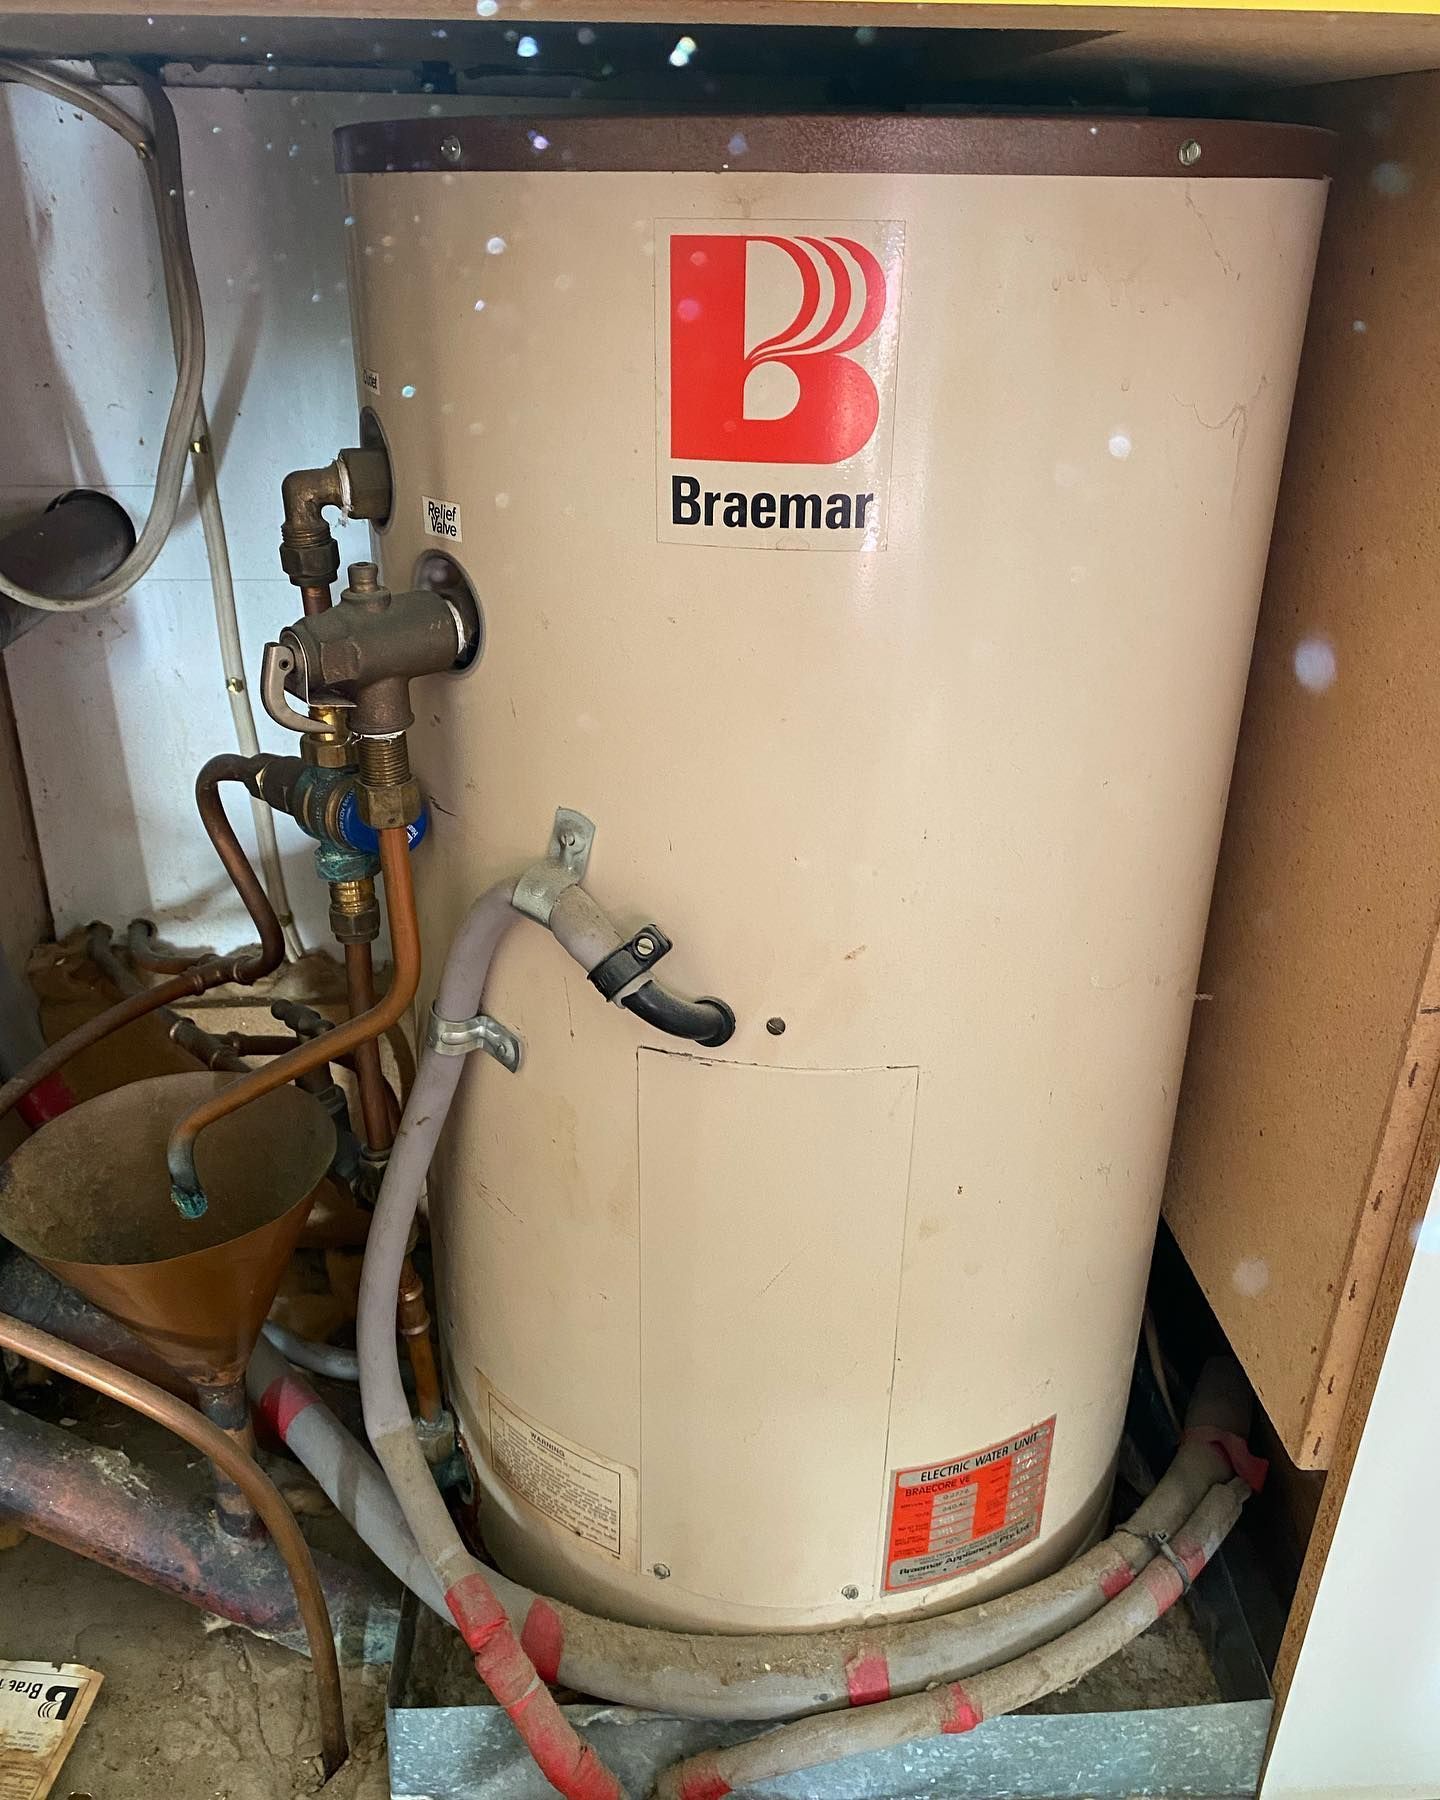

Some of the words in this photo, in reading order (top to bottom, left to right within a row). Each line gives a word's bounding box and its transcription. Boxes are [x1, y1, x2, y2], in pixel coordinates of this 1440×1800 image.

[428, 501, 457, 522] Relief
[672, 474, 874, 529] Braemar
[431, 516, 457, 537] Valve
[530, 1431, 565, 1458] WARNING
[921, 1460, 969, 1482] ELECTRIC
[975, 1446, 1009, 1467] WATER
[1014, 1431, 1039, 1451] UNIT
[905, 1478, 959, 1497] BRAECORE
[945, 1540, 998, 1566] Appliances
